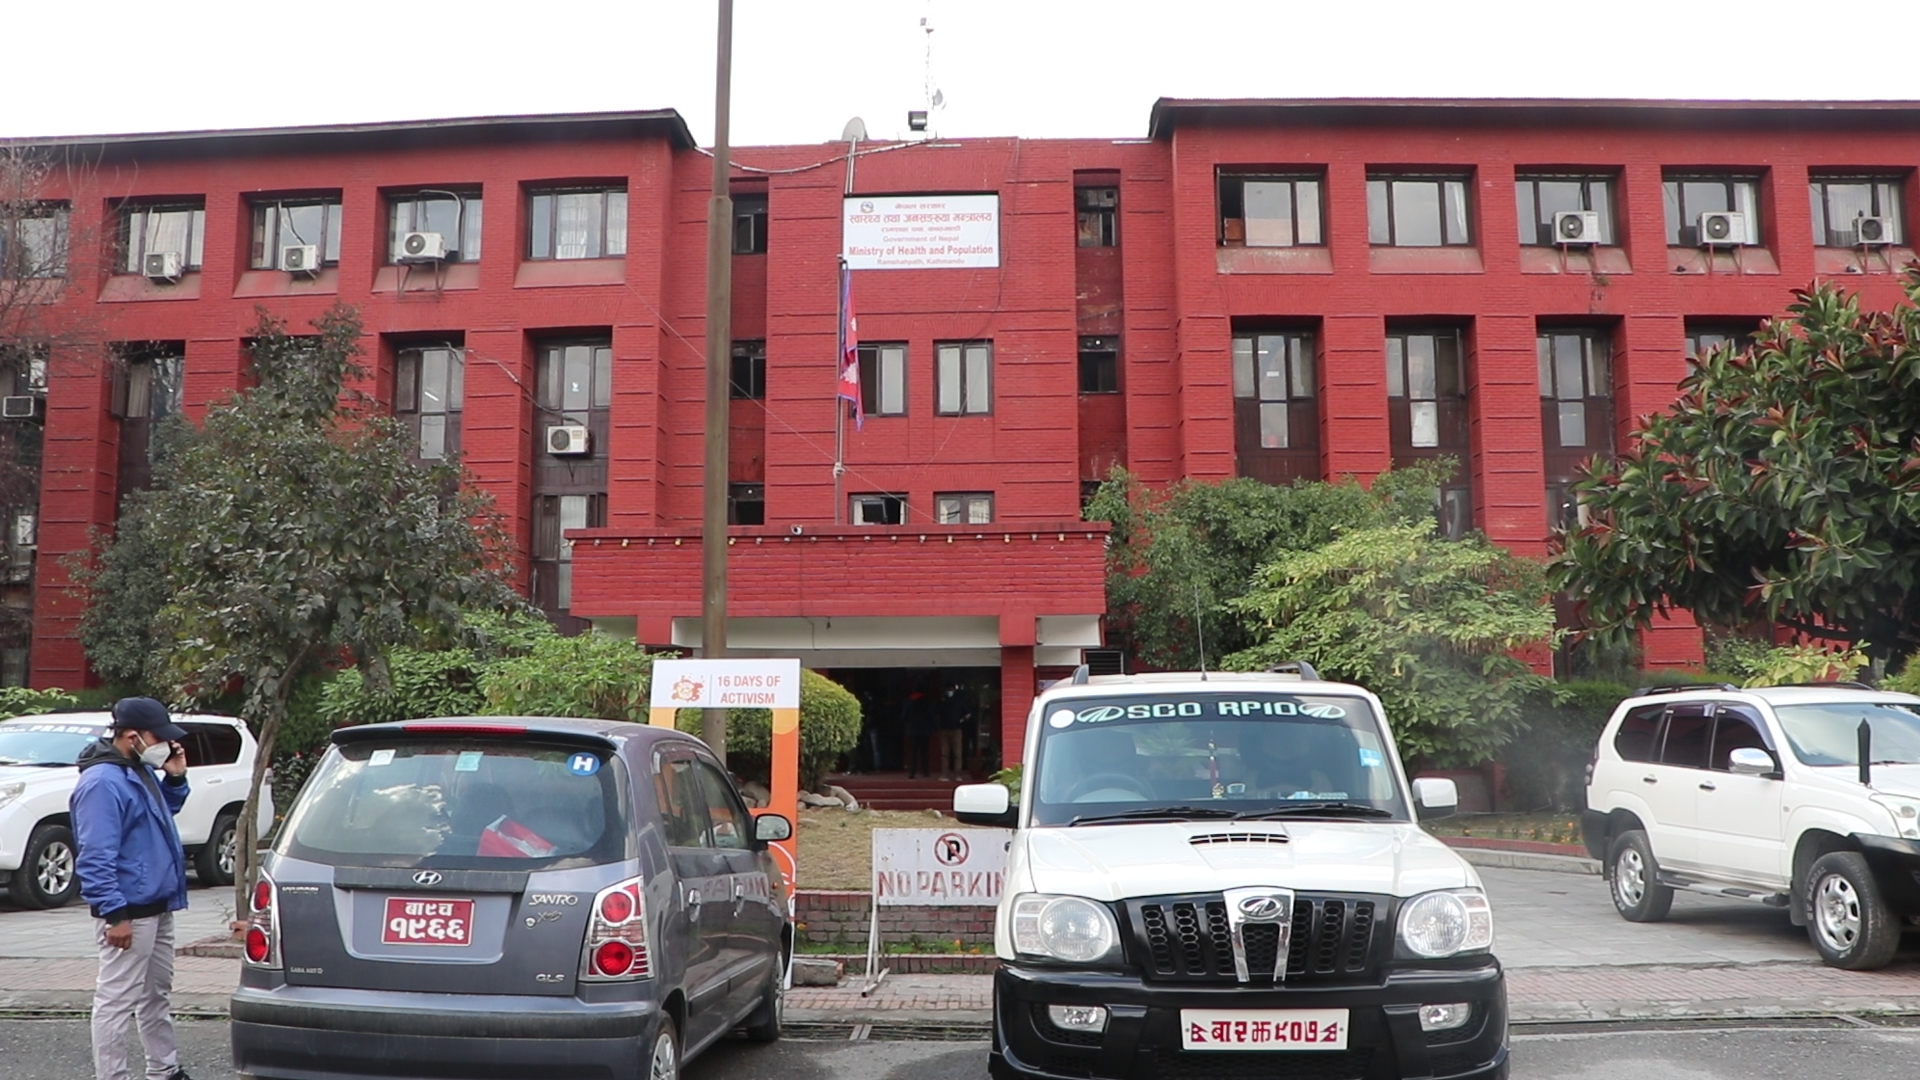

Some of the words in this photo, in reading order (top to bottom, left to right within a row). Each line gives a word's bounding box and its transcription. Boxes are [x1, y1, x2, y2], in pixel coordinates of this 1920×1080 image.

[883, 213, 900, 223] तथा
[938, 235, 960, 243] Nepal
[849, 246, 884, 257] Ministry
[886, 246, 895, 255] of
[898, 246, 927, 255] Health
[928, 246, 945, 255] and
[947, 245, 994, 257] Population
[718, 676, 731, 687] 16
[733, 675, 763, 687] DAYS
[766, 675, 781, 687] OF
[720, 692, 775, 704] ACTIVISM
[29, 724, 93, 735] PRADO
[573, 756, 594, 771] H
[878, 870, 911, 897] NO
[917, 870, 1006, 898] PARKIN
[528, 894, 578, 906] SANTRO
[536, 973, 565, 982] GLS
